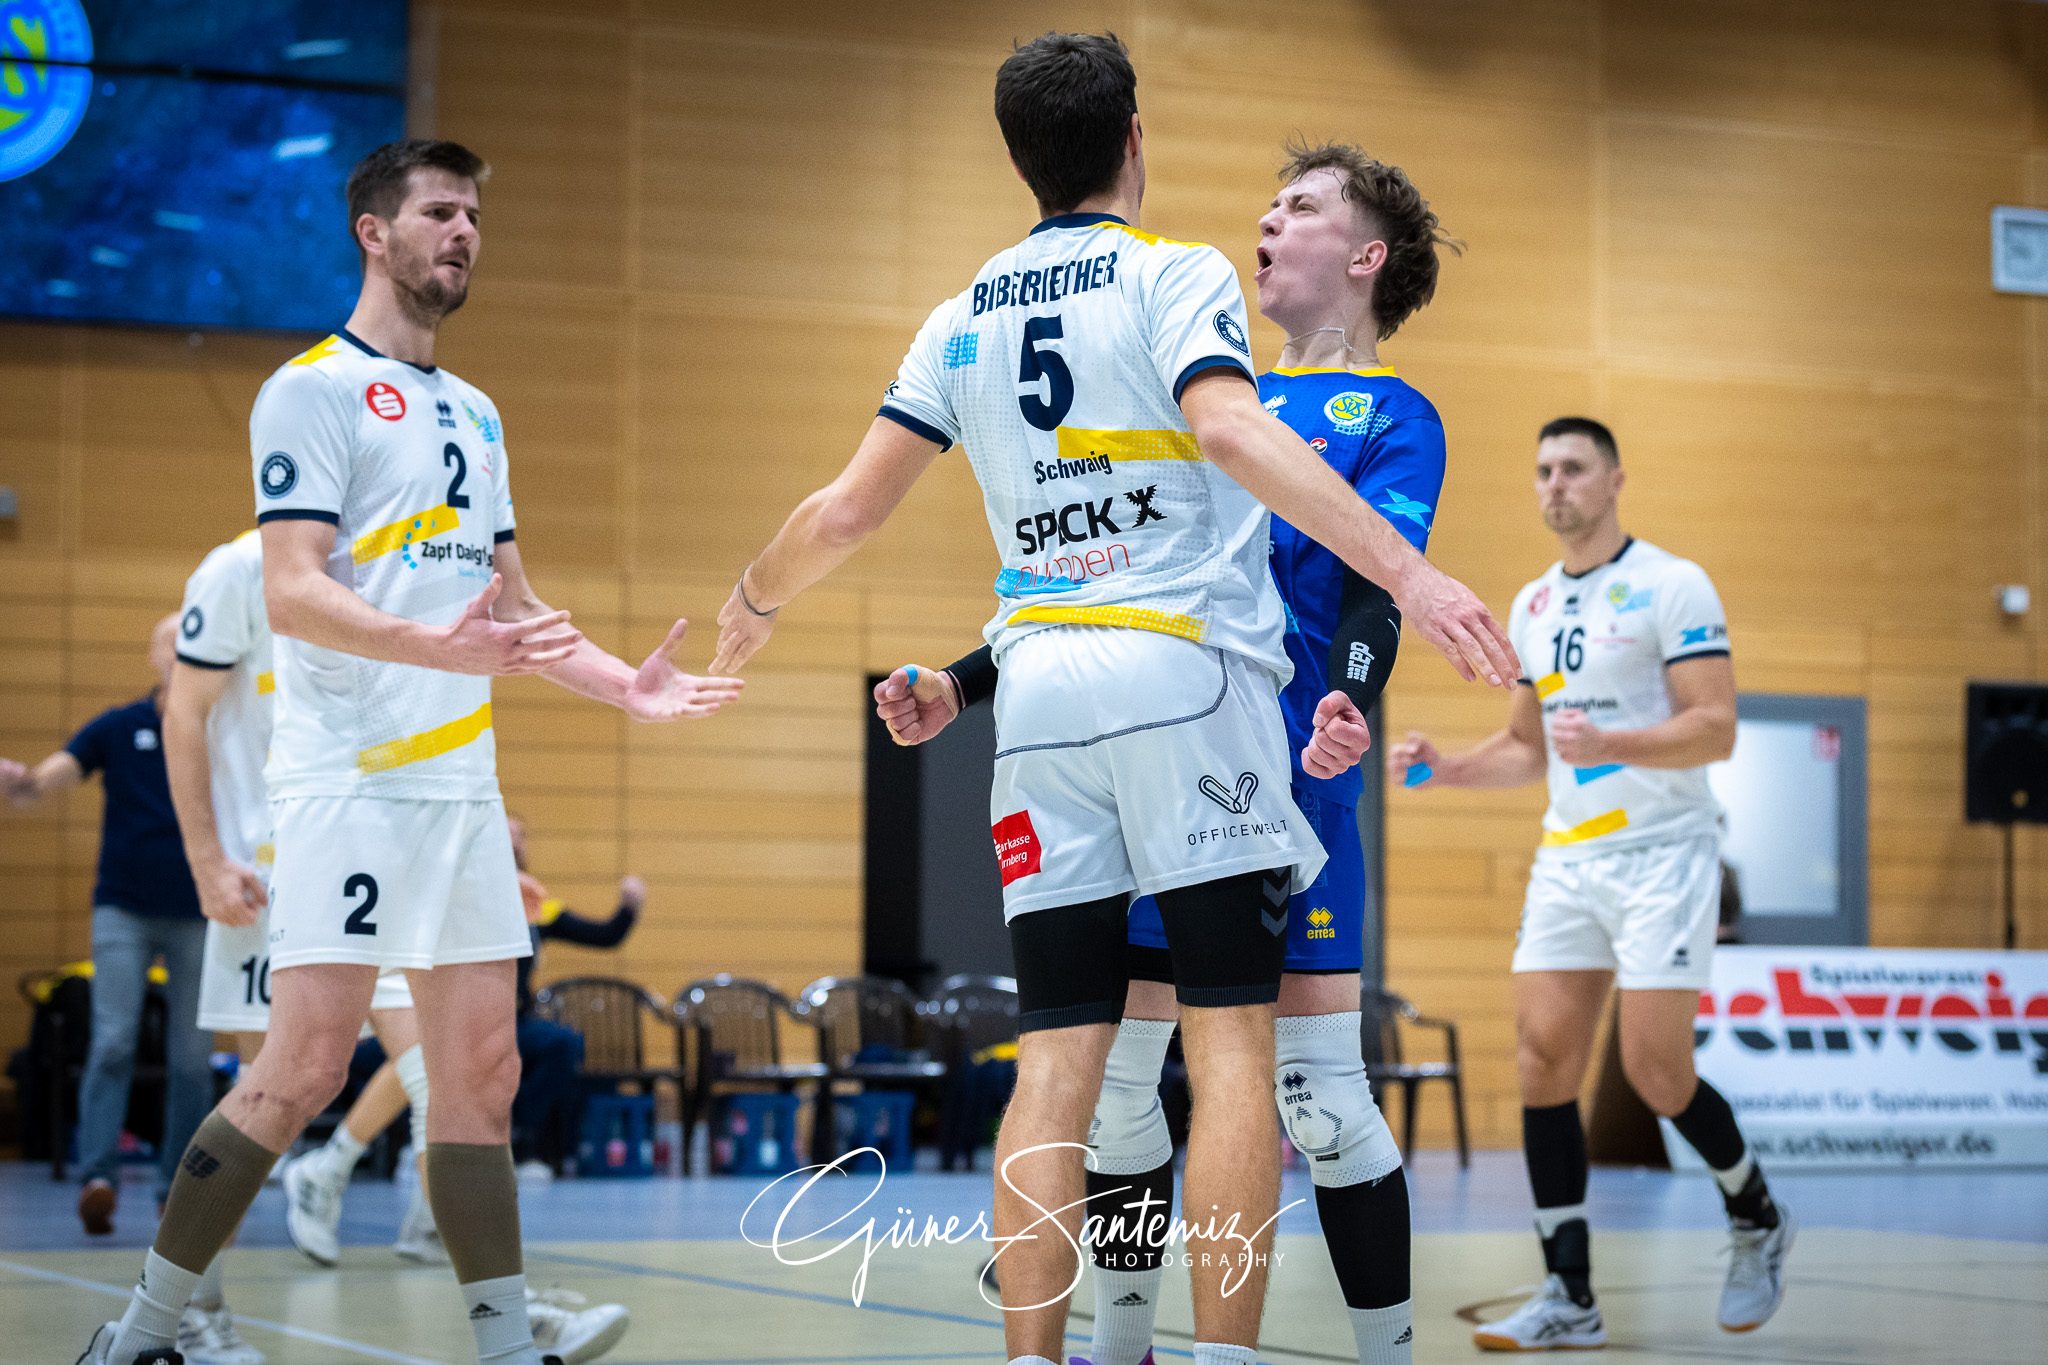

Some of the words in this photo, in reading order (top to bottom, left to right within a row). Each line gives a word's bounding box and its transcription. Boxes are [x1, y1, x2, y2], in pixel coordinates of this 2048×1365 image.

[1018, 313, 1075, 431] 5
[443, 442, 471, 509] 2
[1034, 451, 1113, 485] Schwaig
[421, 541, 452, 562] Zapf
[1553, 626, 1585, 673] 16
[1187, 819, 1289, 846] OFFICEWELT
[343, 872, 379, 936] 2
[1306, 927, 1336, 940] errea
[1284, 1090, 1313, 1106] errea
